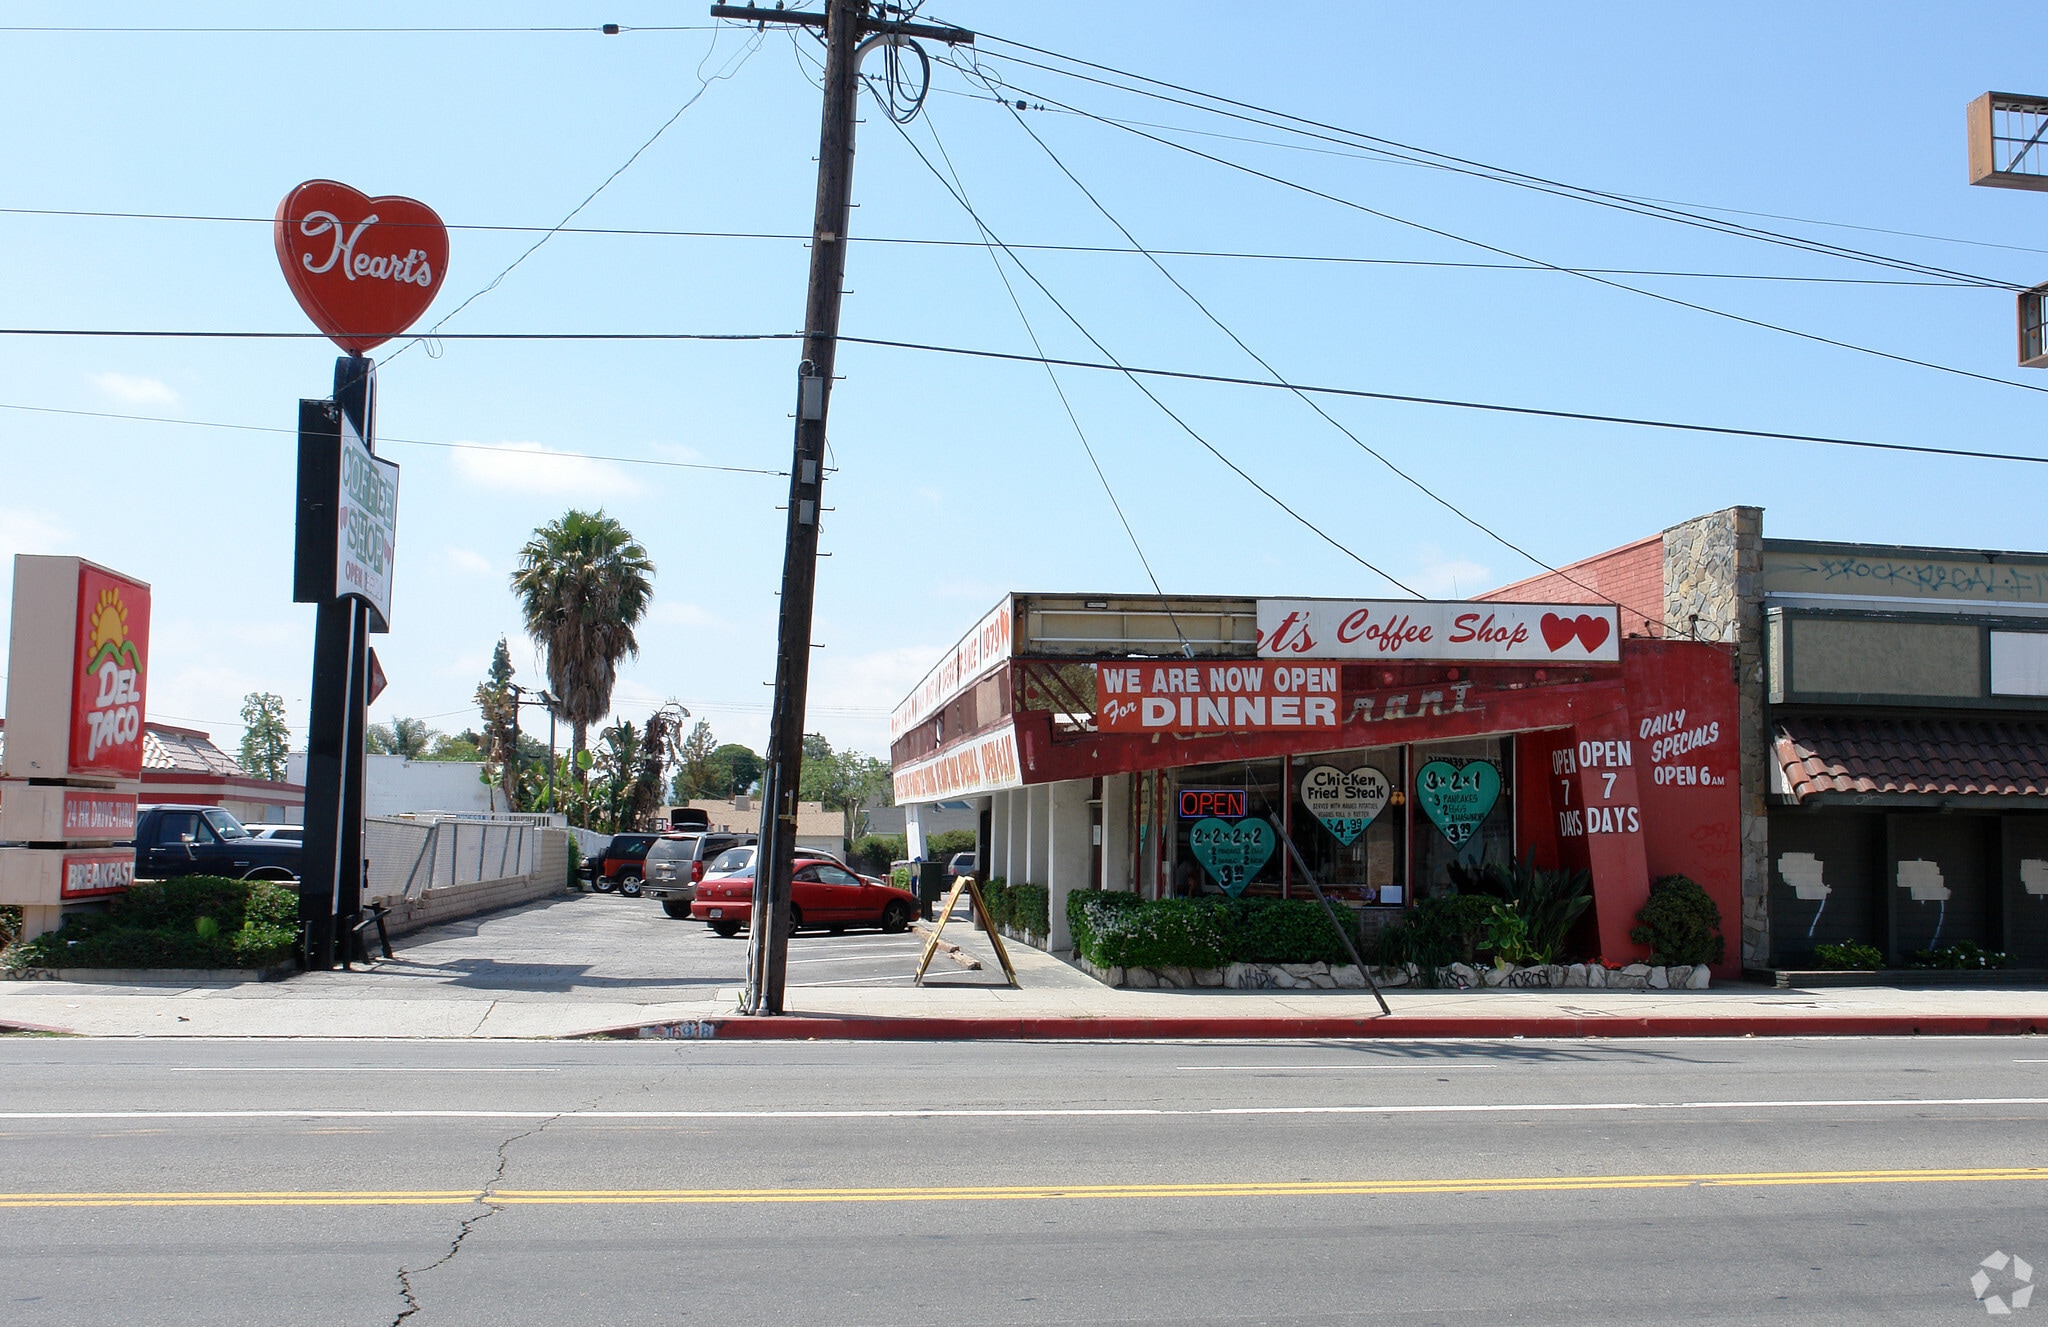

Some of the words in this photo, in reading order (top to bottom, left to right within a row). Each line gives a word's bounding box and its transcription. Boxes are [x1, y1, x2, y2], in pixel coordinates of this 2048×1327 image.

[301, 211, 432, 286] Heart's
[343, 446, 394, 531] COFFEE
[347, 509, 385, 576] SHOP
[346, 560, 362, 589] OPEN
[983, 618, 1000, 661] 1979
[1337, 608, 1434, 653] Coffee
[1448, 613, 1530, 652] Shop
[95, 661, 140, 708] DEL
[1103, 668, 1141, 693] WE
[1152, 668, 1200, 693] ARE
[1210, 667, 1263, 692] NOW
[1274, 667, 1337, 692] OPEN
[1103, 699, 1137, 726] For
[1142, 696, 1337, 727] DINNER
[1639, 708, 1686, 740] DAILY
[87, 704, 138, 761] TACO
[1651, 721, 1719, 763] SPECIALS
[1552, 748, 1577, 776] OPEN
[1578, 740, 1632, 768] OPEN
[1602, 772, 1617, 799] 7
[1653, 766, 1697, 785] OPEN
[1181, 792, 1244, 816] OPEN
[1308, 787, 1338, 799] Fried
[1434, 794, 1440, 806] 3
[1443, 794, 1478, 803] PANCAKES
[1561, 779, 1570, 806] 7
[66, 800, 77, 828] 24
[78, 801, 90, 828] HR
[91, 801, 134, 828] DRIVE-THRU
[1442, 805, 1448, 815] 2
[1559, 810, 1582, 837] DAYS
[1587, 807, 1640, 834] DAYS
[1211, 847, 1216, 855] 2
[1244, 845, 1249, 855] 2
[1211, 856, 1216, 865] 2
[1244, 856, 1249, 865] 2
[66, 862, 135, 891] BREAKFAST
